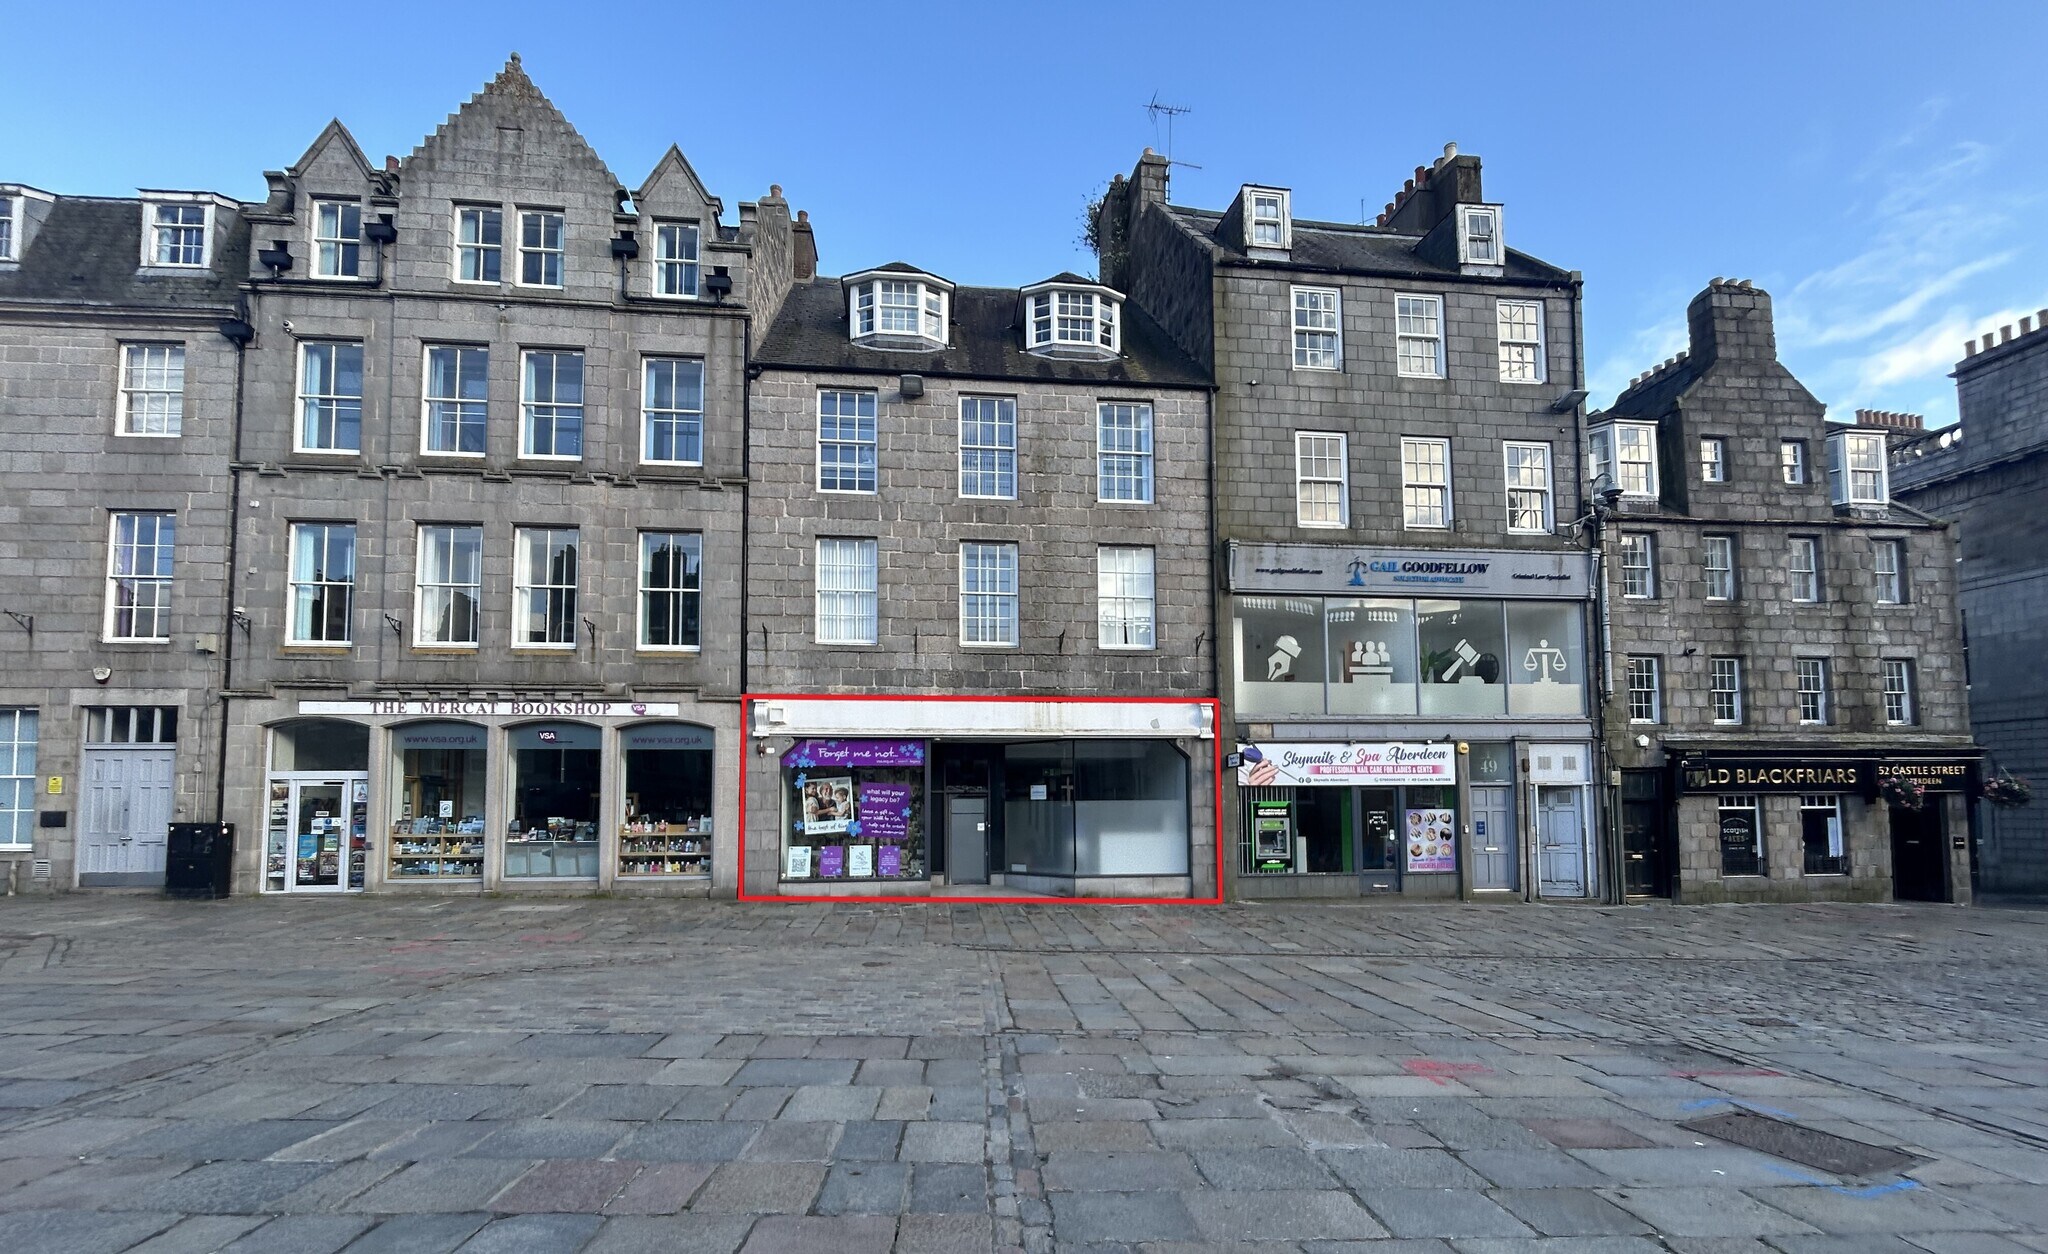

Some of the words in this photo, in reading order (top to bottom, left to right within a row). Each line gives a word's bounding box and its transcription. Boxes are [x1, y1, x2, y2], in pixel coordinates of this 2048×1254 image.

[1370, 561, 1399, 572] GAIL
[1402, 561, 1490, 574] GOODFELLOW
[369, 702, 407, 714] THE
[420, 702, 499, 714] MERCAT
[511, 702, 612, 716] BOOKSHOP
[404, 735, 477, 745] www.vsa.org.uk
[631, 736, 703, 745] www.vsa.org.uk
[817, 747, 850, 761] Forget
[853, 750, 872, 758] me
[1281, 750, 1337, 768] Skynails
[1340, 751, 1352, 763] &
[1355, 748, 1382, 766] Spa
[1386, 746, 1448, 764] Aberdeen
[1357, 766, 1370, 774] NAIL
[1370, 766, 1383, 774] CARE
[1394, 765, 1412, 773] LADIES
[1417, 765, 1433, 773] GENTS
[1480, 760, 1498, 773] 49
[1878, 766, 1890, 775] 52
[1891, 766, 1929, 775] CASTLE
[1930, 766, 1967, 775] STREET
[1706, 768, 1731, 783] LD
[1736, 768, 1857, 784] BLACKFRIARS
